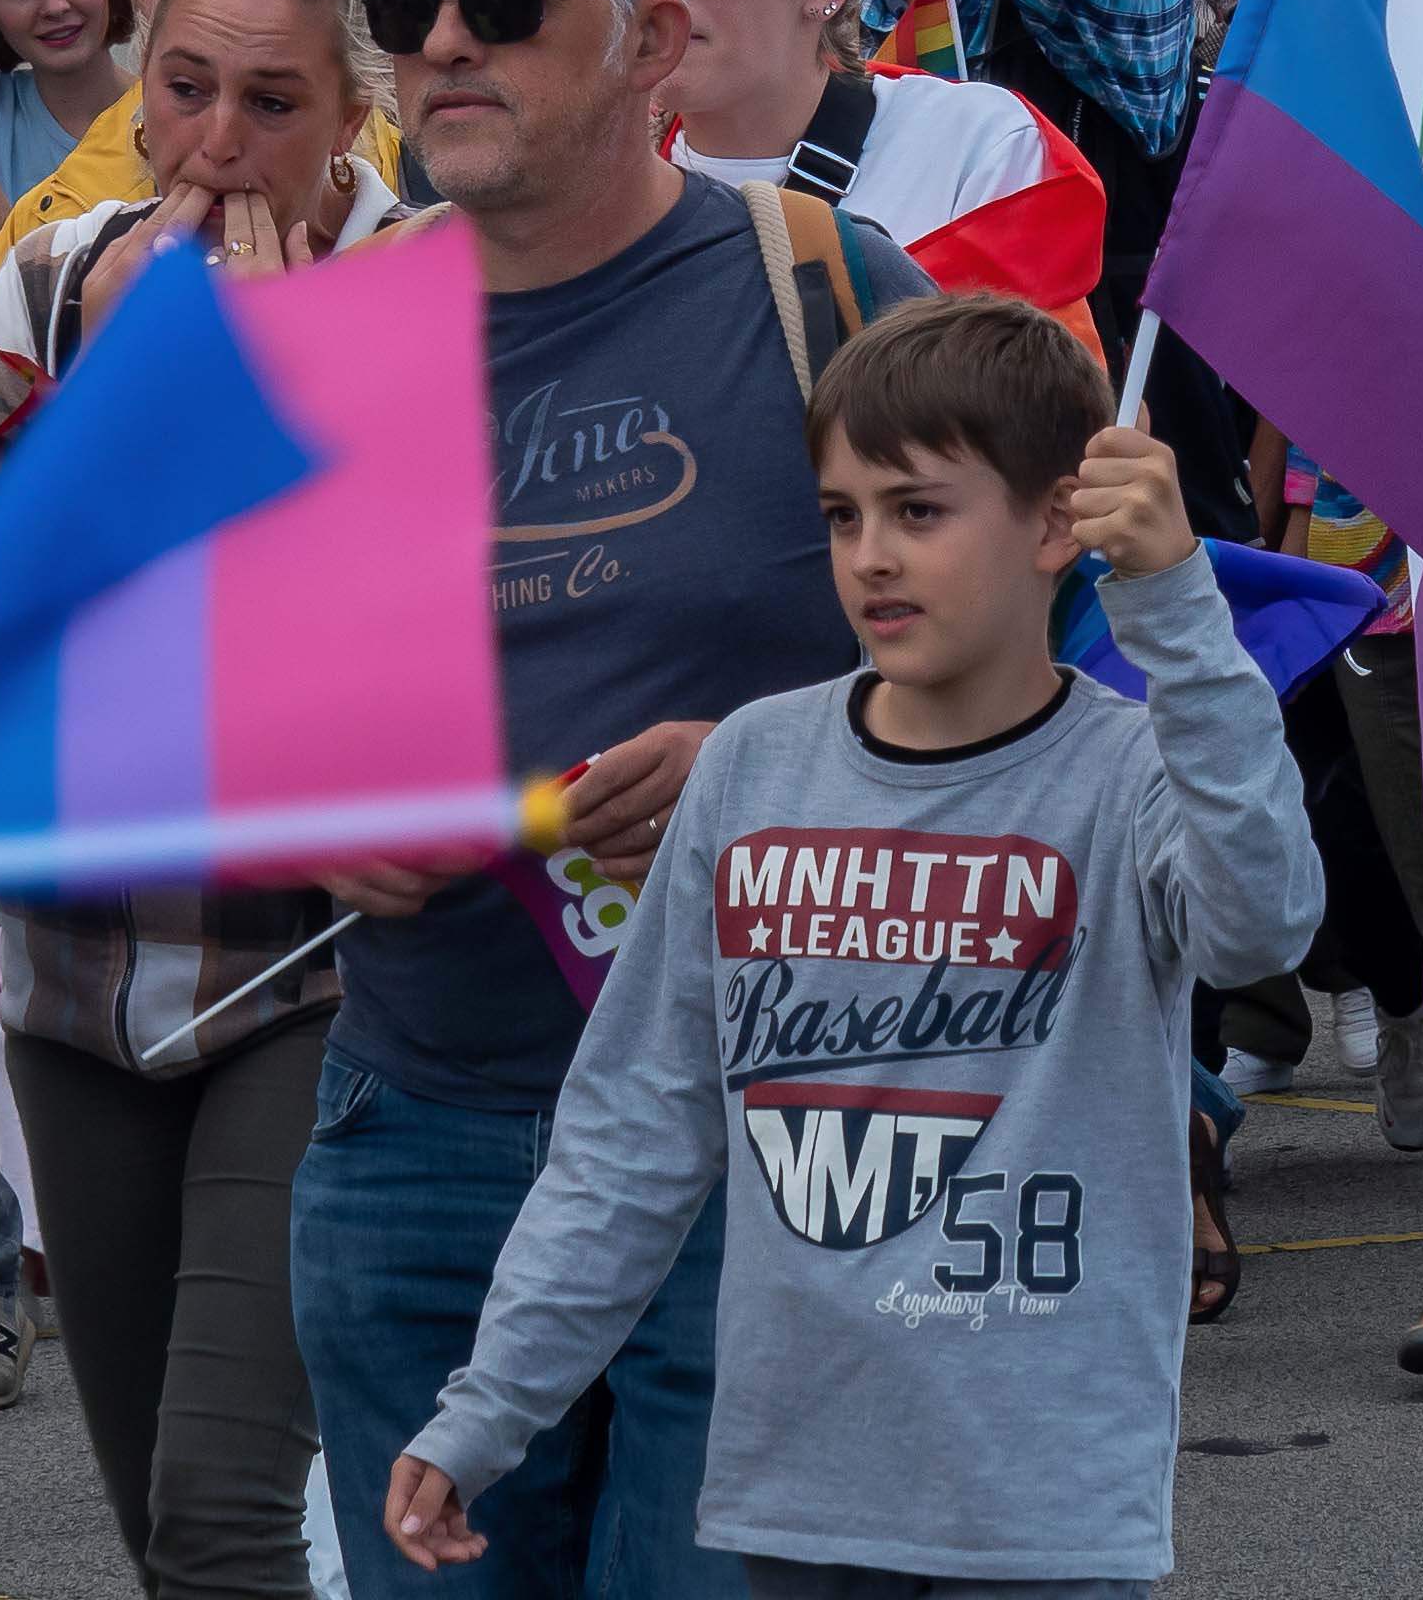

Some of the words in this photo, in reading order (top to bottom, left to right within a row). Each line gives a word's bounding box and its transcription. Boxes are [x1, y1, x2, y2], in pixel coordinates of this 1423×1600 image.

[577, 465, 658, 502] MAKERS
[728, 844, 1059, 920] MNHTTN
[779, 914, 980, 965] LEAGUE
[722, 925, 1087, 1072] Baseball
[874, 1281, 988, 1331] Legendary
[994, 1286, 1060, 1316] Team
